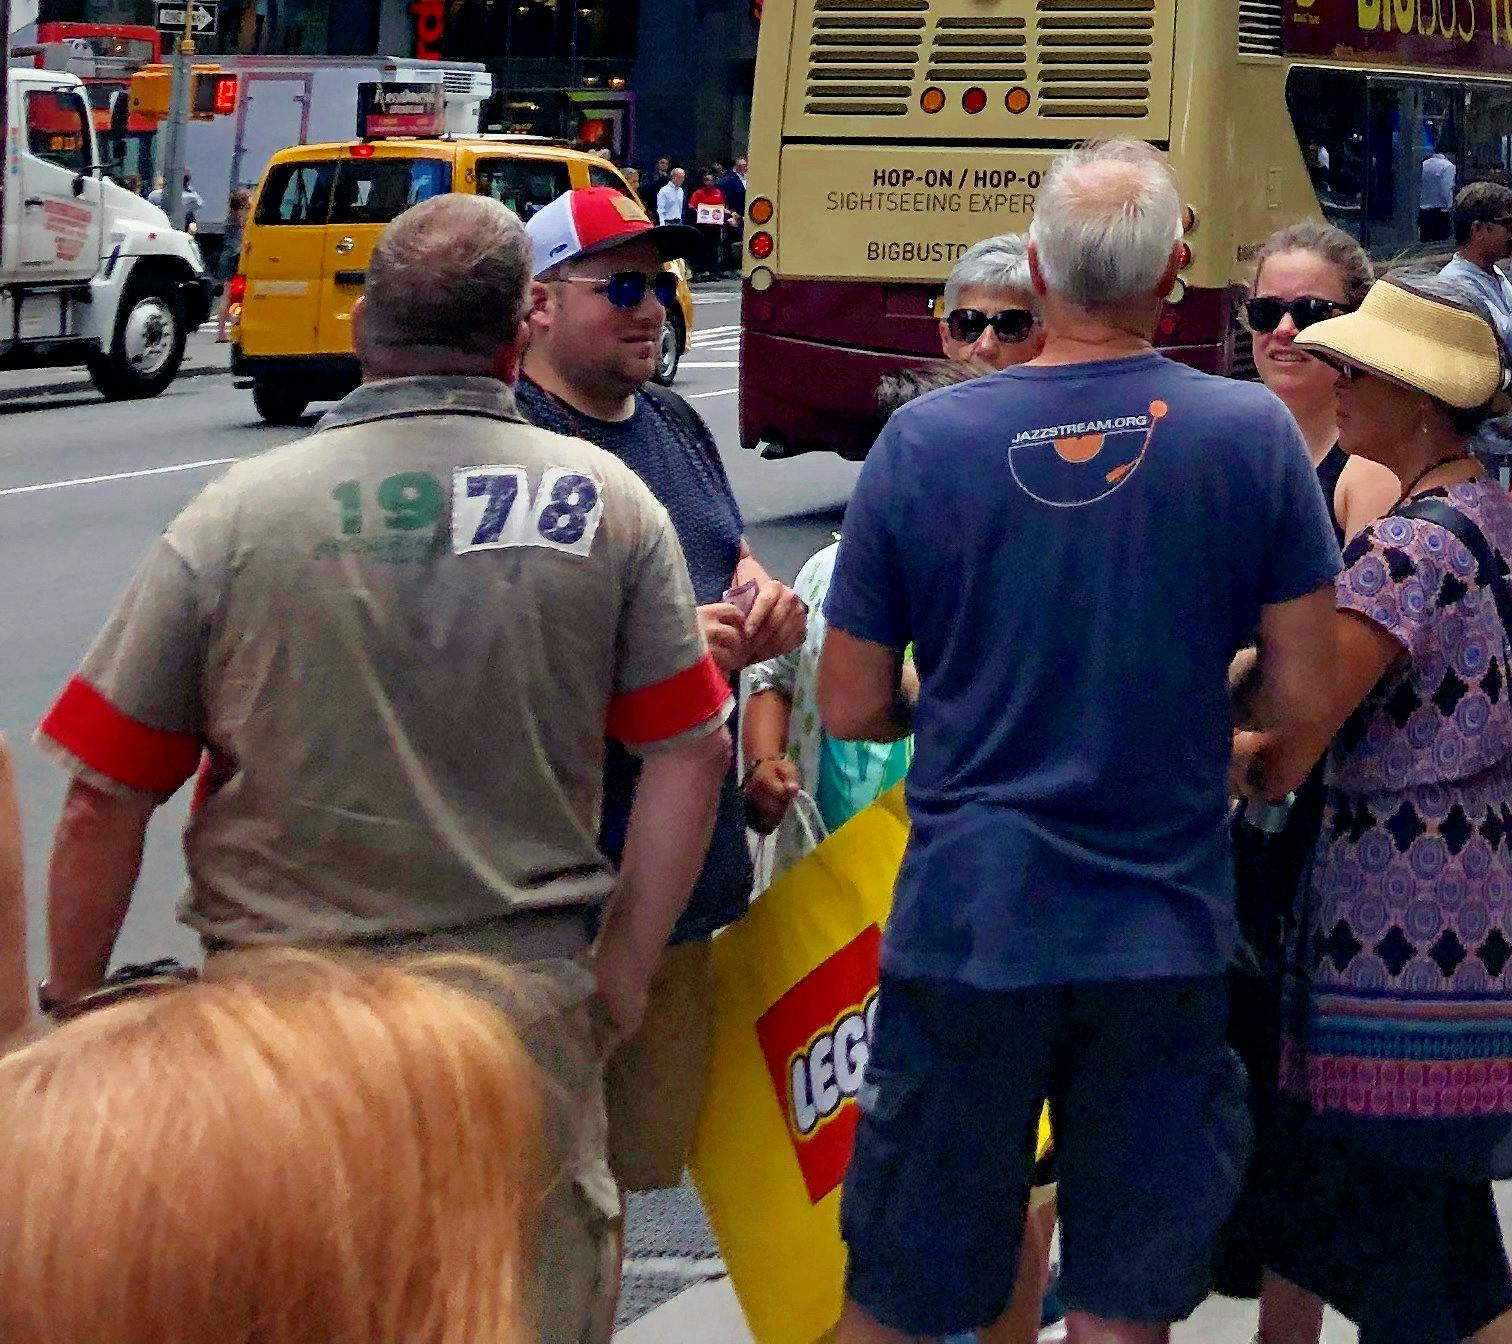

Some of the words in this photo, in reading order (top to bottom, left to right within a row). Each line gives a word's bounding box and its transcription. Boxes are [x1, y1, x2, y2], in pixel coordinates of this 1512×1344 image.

[873, 168, 953, 188] HOP-ON
[973, 169, 1046, 189] HOP-O
[827, 191, 962, 212] SIGHTSEEING
[969, 192, 1035, 213] EXPER
[867, 241, 968, 262] BIGBUSTO
[1012, 415, 1148, 443] JAZZSTREAM.ORG
[331, 470, 599, 546] 1978
